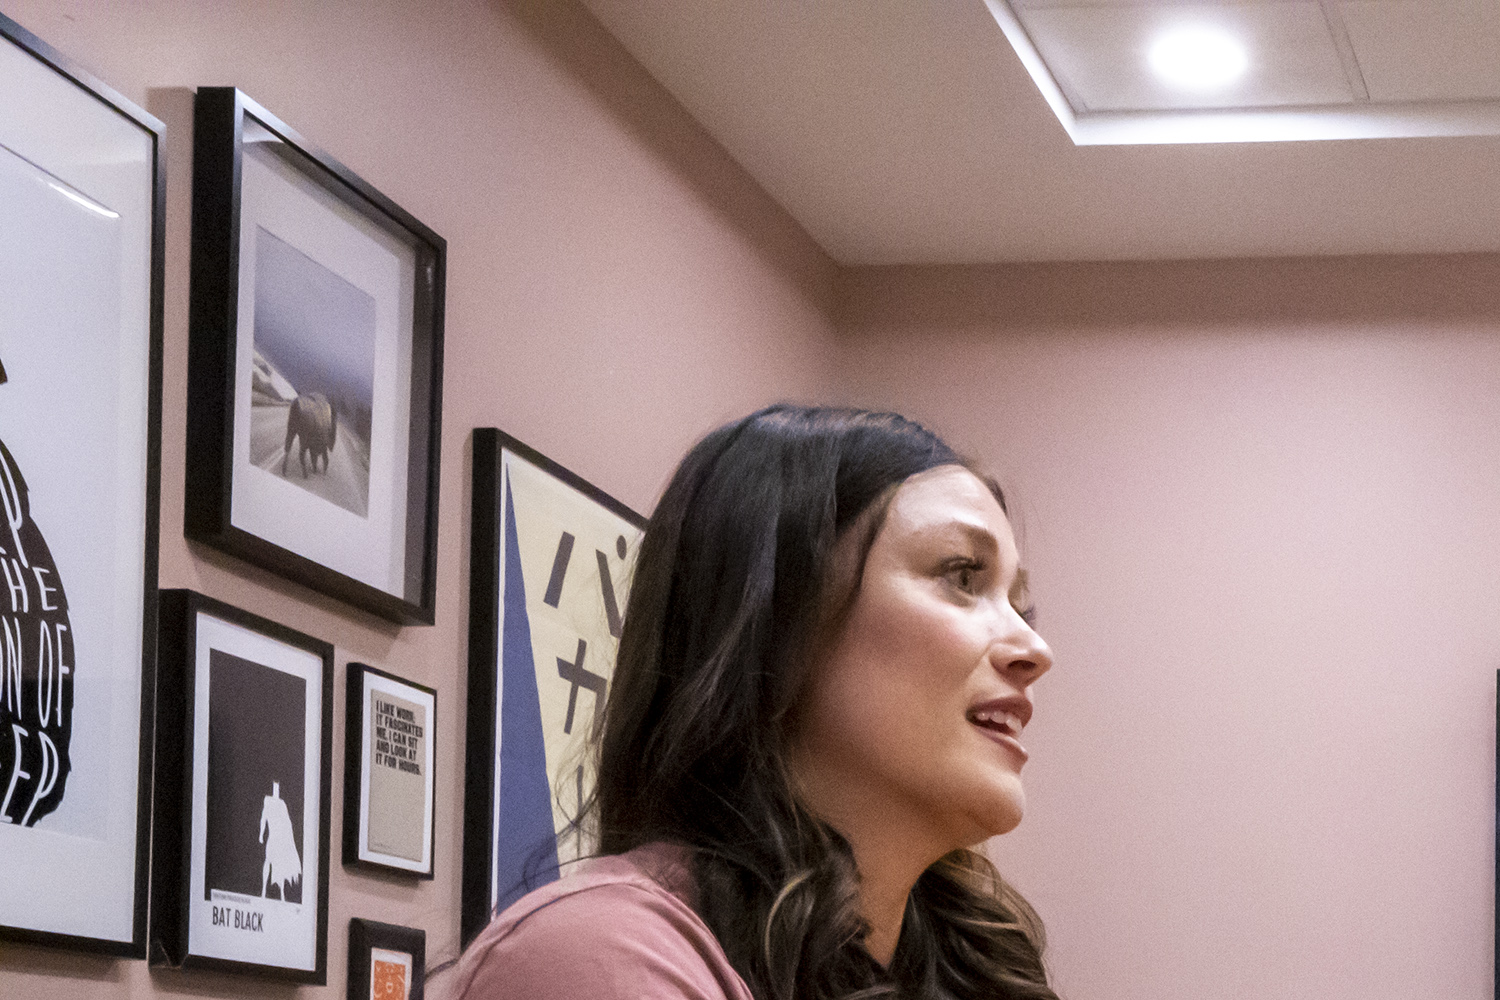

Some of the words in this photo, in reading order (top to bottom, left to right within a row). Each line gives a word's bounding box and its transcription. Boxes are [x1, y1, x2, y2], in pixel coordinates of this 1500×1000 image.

[38, 619, 70, 729] OF
[380, 701, 394, 716] LIKE
[376, 713, 383, 725] IT
[385, 715, 423, 738] FASCINATES
[376, 739, 389, 754] AND
[391, 744, 407, 759] LOOK
[408, 749, 417, 761] AT
[393, 732, 406, 745] CAN
[408, 736, 418, 750] SIT
[375, 752, 382, 765] IT
[384, 754, 397, 769] FOR
[212, 905, 231, 928] BAT
[234, 909, 264, 932] BLACK
